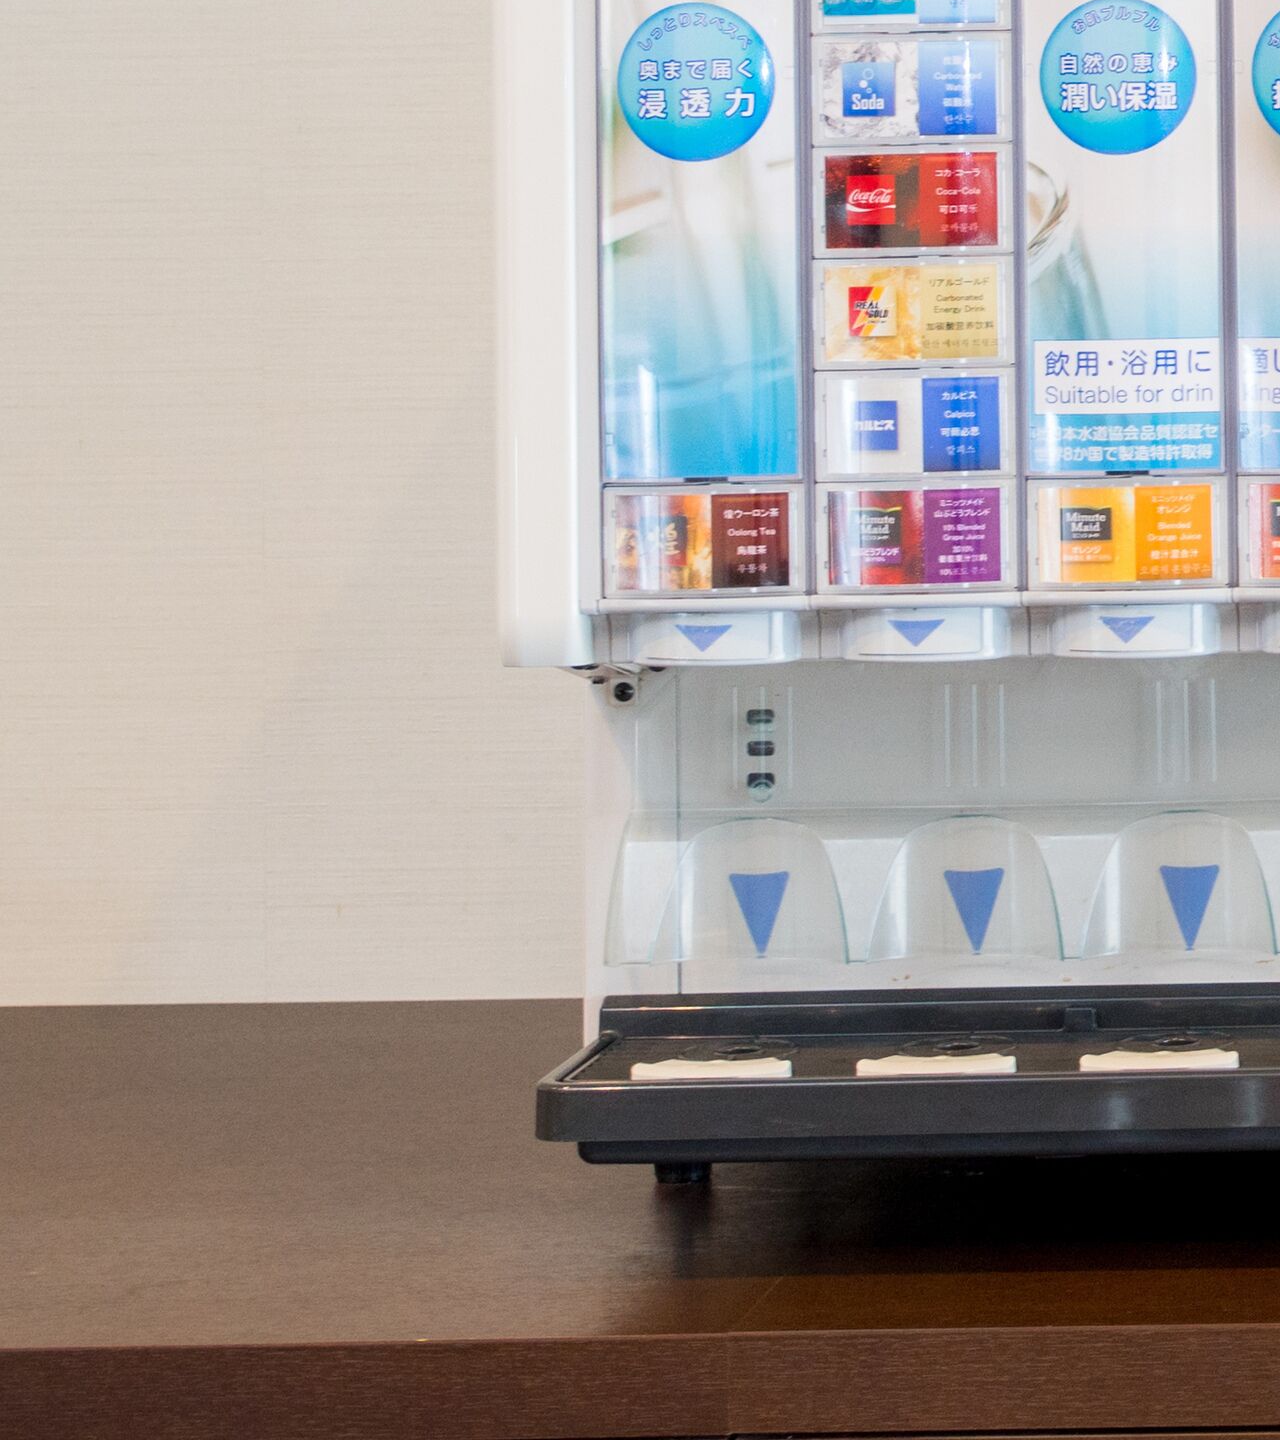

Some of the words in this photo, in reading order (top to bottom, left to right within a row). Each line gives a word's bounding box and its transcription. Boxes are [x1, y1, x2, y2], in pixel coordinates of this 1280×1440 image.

[638, 59, 753, 81] 奥まで届く
[1060, 53, 1178, 75] 自然の恵み
[638, 87, 756, 119] 浸透力
[852, 94, 884, 110] Soda
[1061, 81, 1178, 112] 潤い保湿
[1045, 384, 1128, 404] Suitable
[1135, 385, 1163, 403] for
[1065, 512, 1106, 522] Minute
[727, 528, 757, 537] Oolong
[759, 527, 776, 536] Tea
[1071, 523, 1101, 532] Maid
